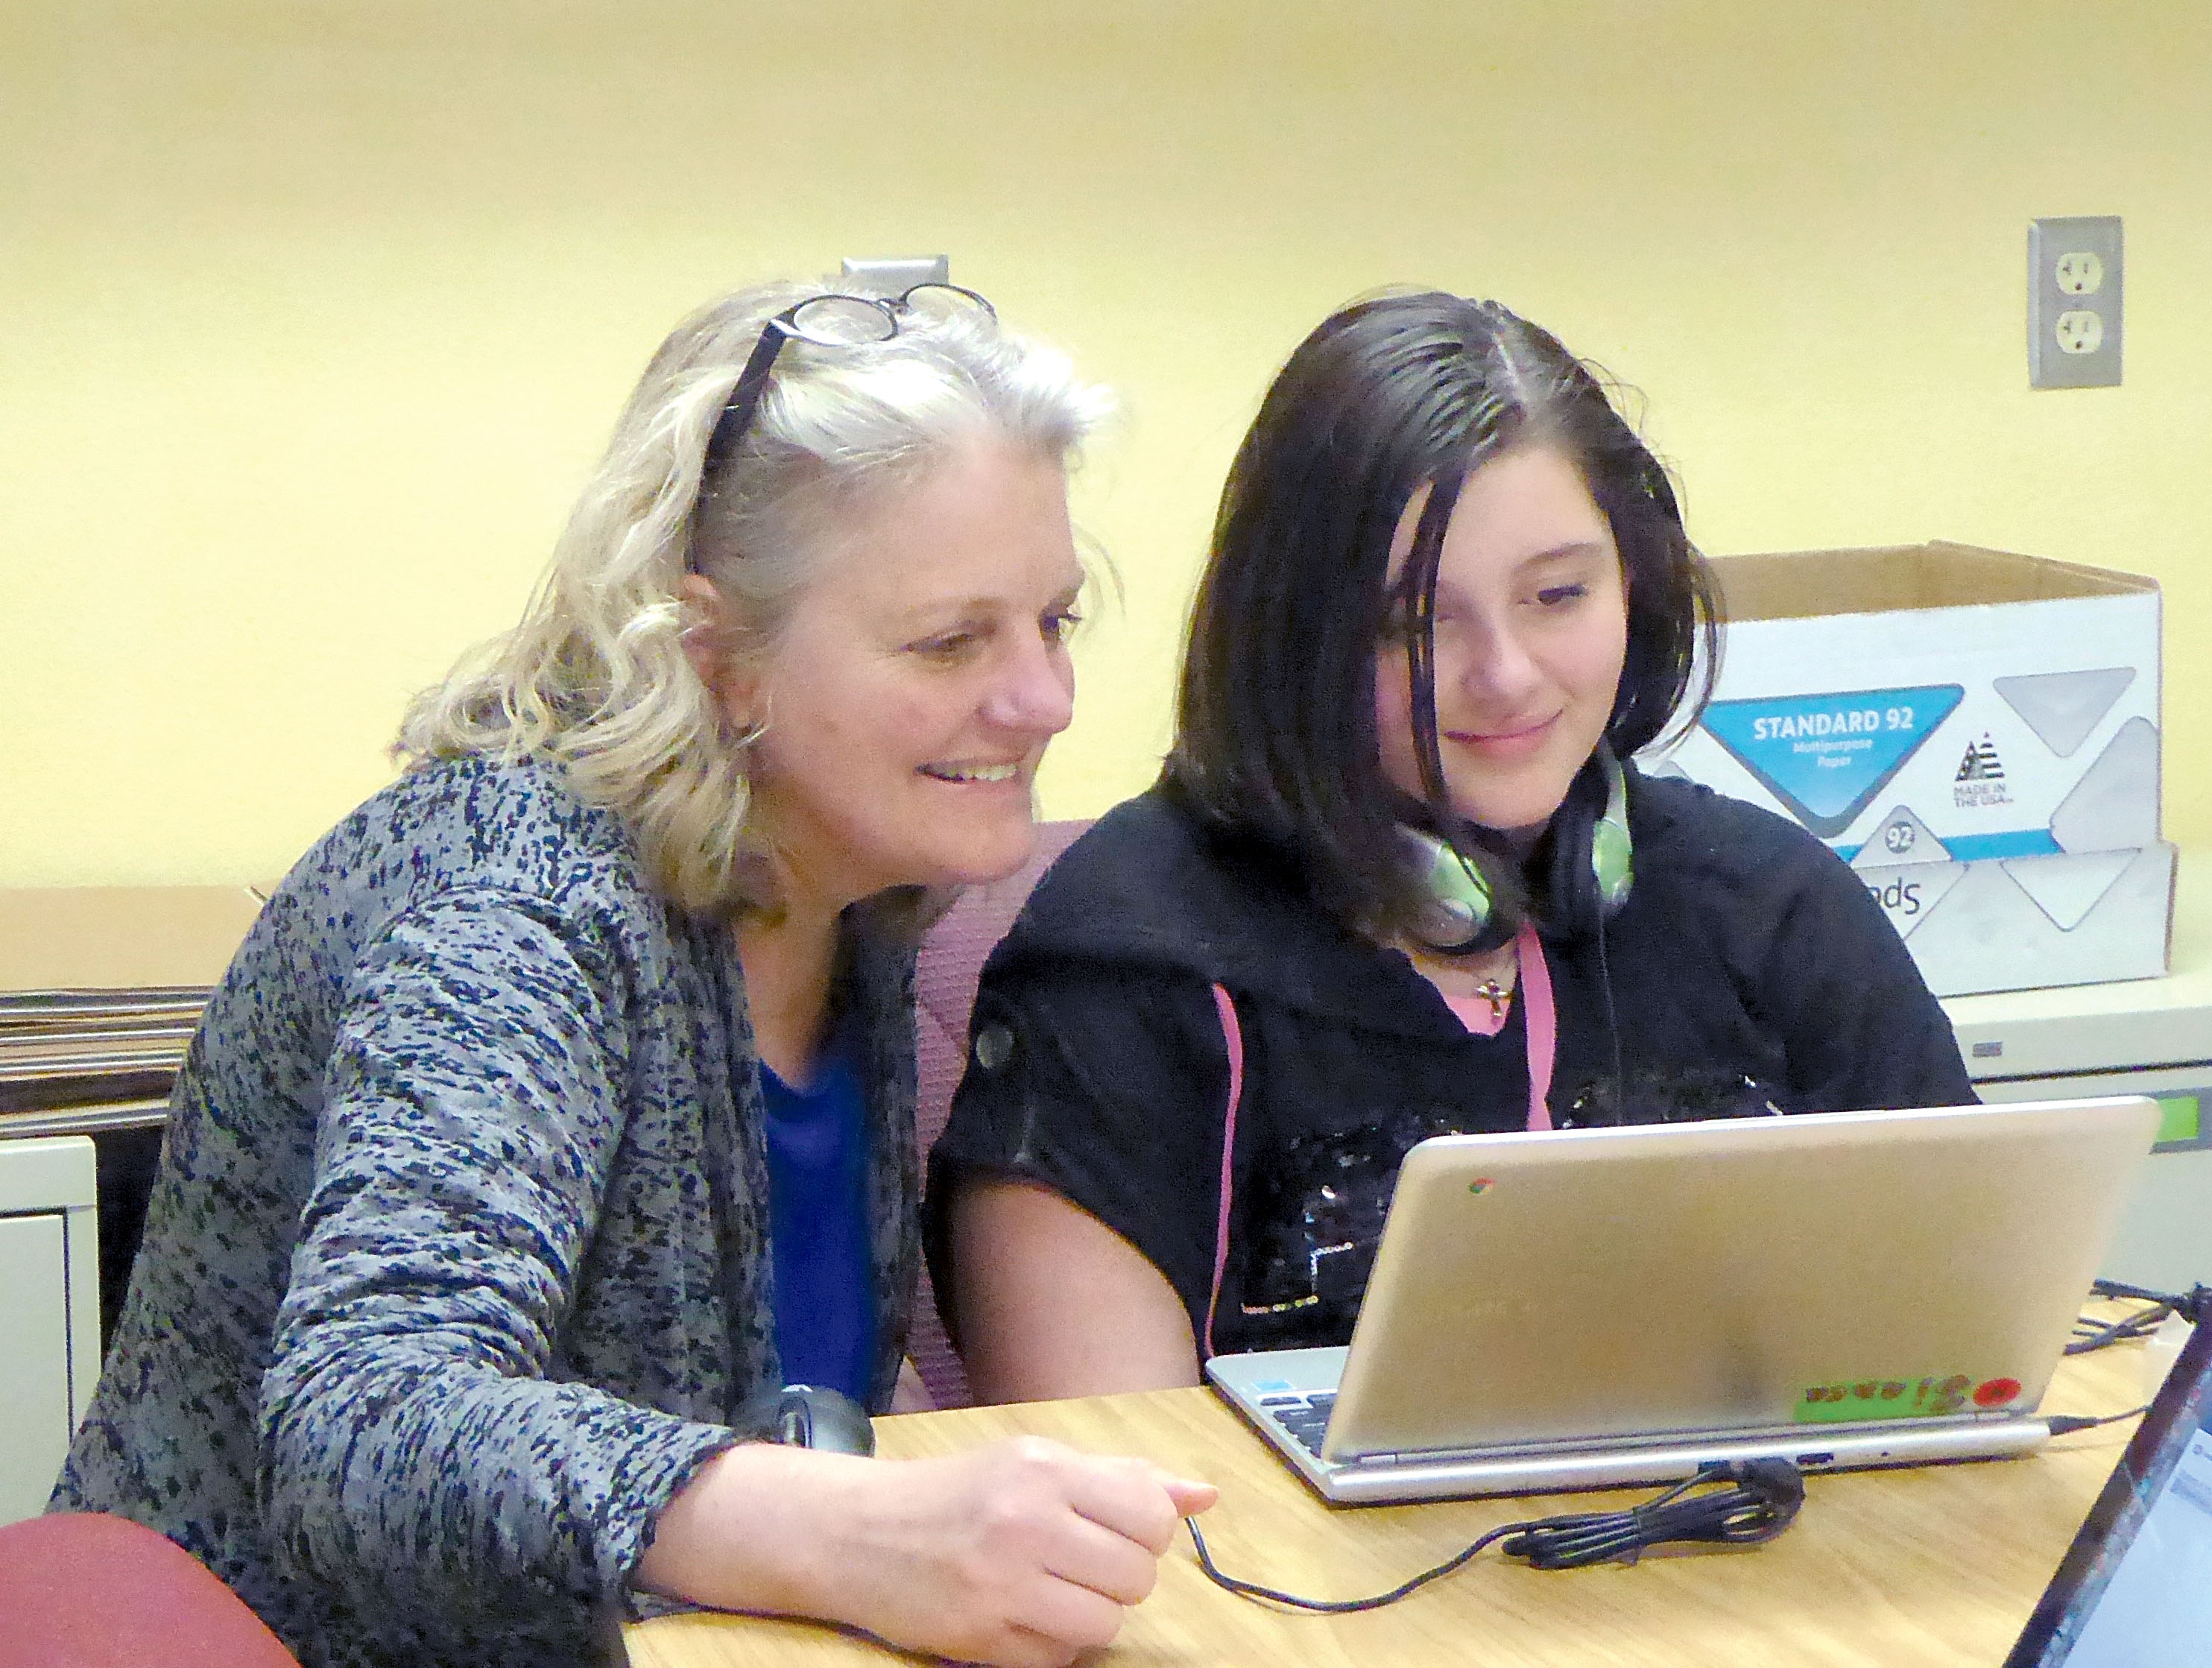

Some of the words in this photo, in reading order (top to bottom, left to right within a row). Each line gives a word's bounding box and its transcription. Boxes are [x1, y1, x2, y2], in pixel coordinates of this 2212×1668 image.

[1754, 710, 1880, 740] STANDARD
[1886, 706, 1914, 730] 92
[1793, 739, 1874, 753] Multipurpose
[1816, 756, 1852, 768] Paper
[1953, 784, 1990, 797] MADE
[1993, 782, 2006, 793] IN
[1953, 796, 1978, 808] THE
[1888, 826, 1912, 848] 92
